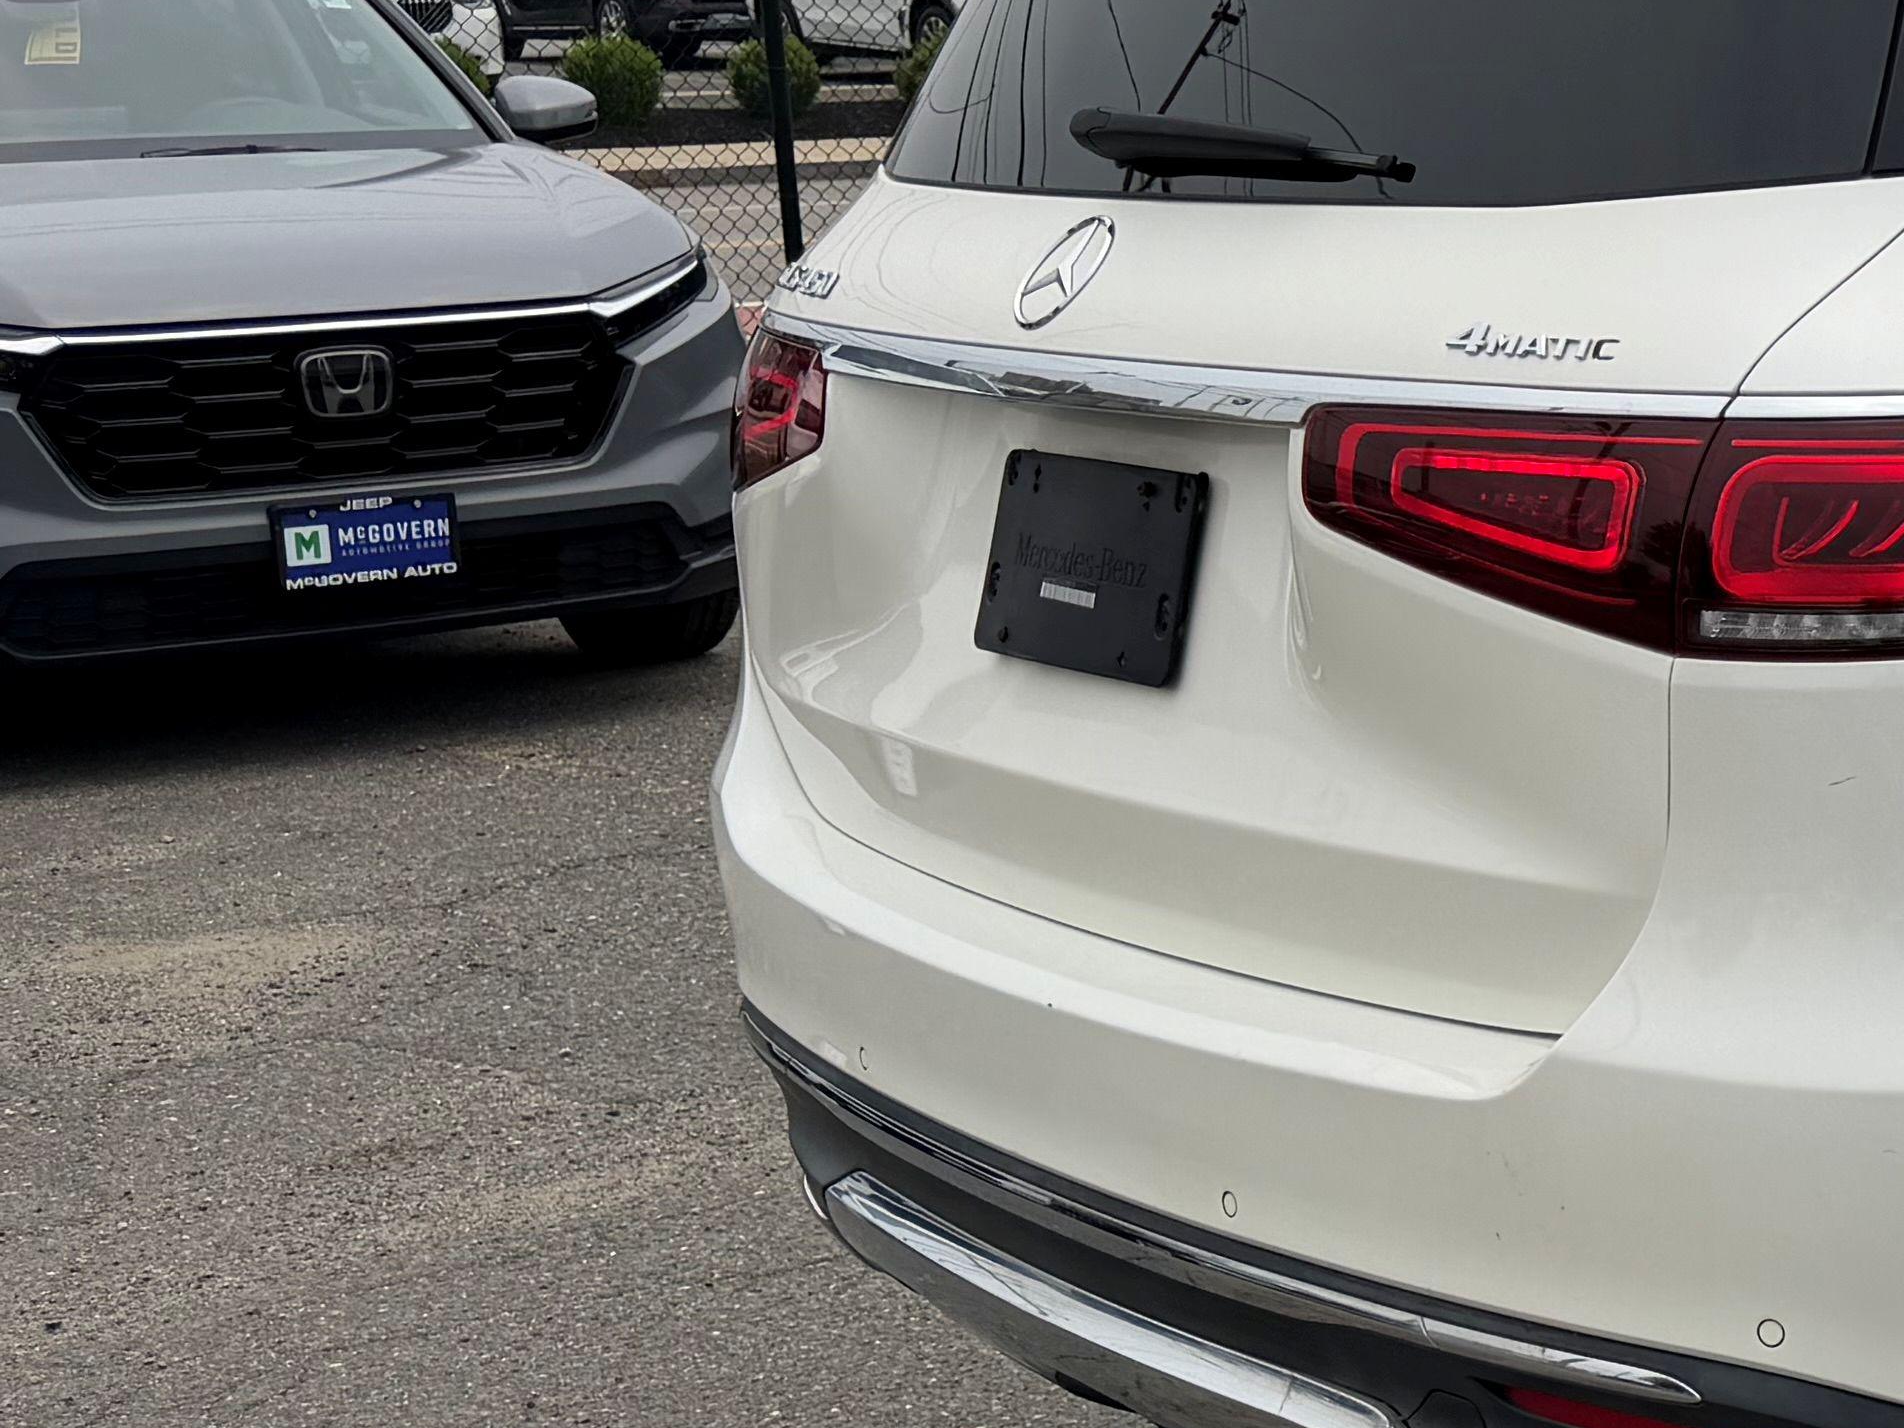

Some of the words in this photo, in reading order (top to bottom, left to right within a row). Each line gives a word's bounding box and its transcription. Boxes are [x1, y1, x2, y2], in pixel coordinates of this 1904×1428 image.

[1445, 322, 1620, 361] 4MATIC
[339, 496, 393, 512] JEEP
[404, 561, 458, 579] AUTO
[1014, 532, 1148, 588] Mercedes-Benz
